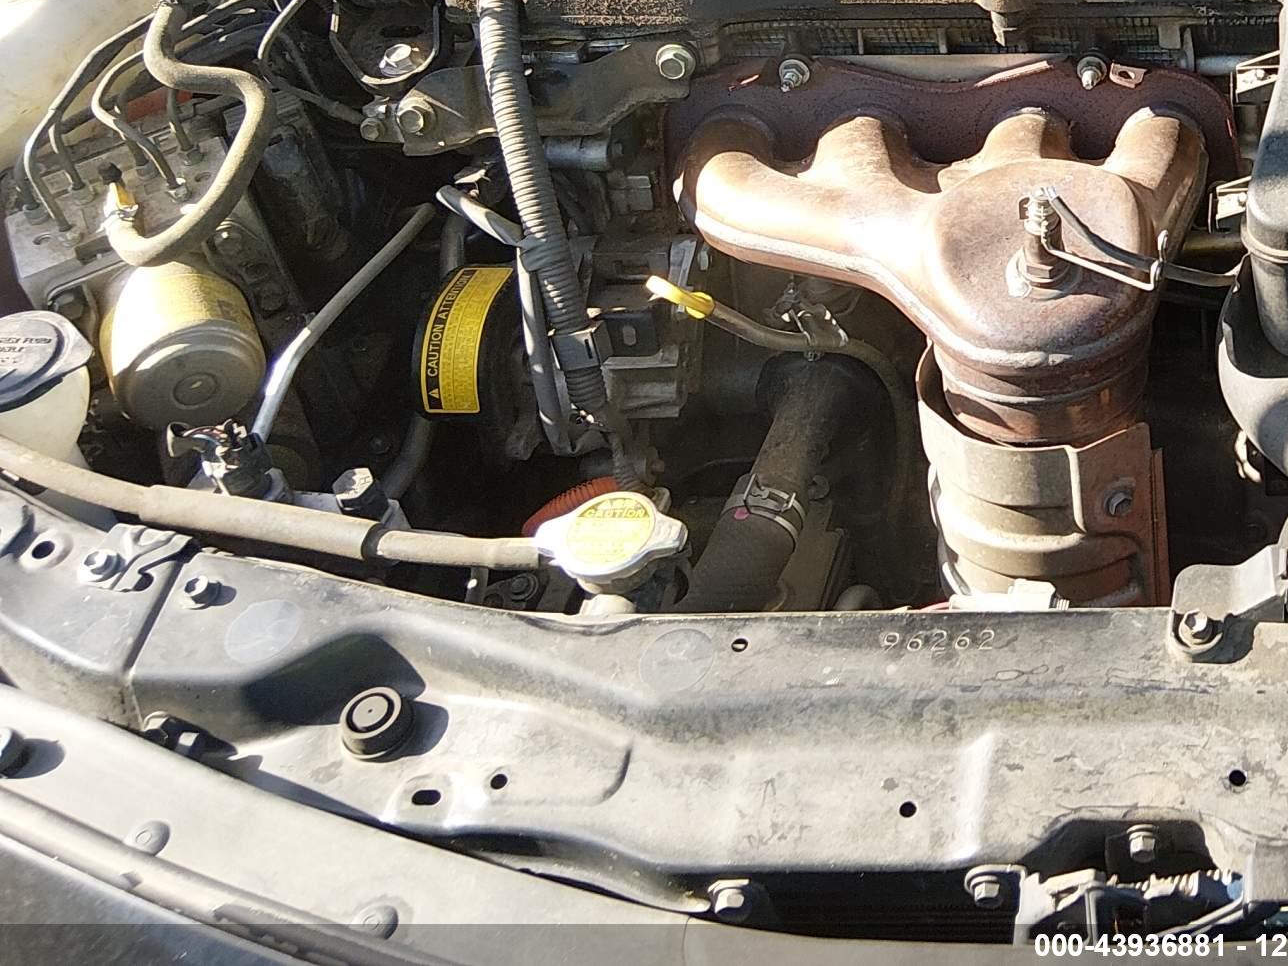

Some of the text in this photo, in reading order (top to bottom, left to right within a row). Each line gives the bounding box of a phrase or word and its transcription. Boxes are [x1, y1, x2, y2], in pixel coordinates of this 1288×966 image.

[427, 324, 444, 377] CAUTION
[438, 272, 472, 320] ATTENTION
[584, 506, 646, 519] CAUTION
[883, 628, 995, 653] 96262
